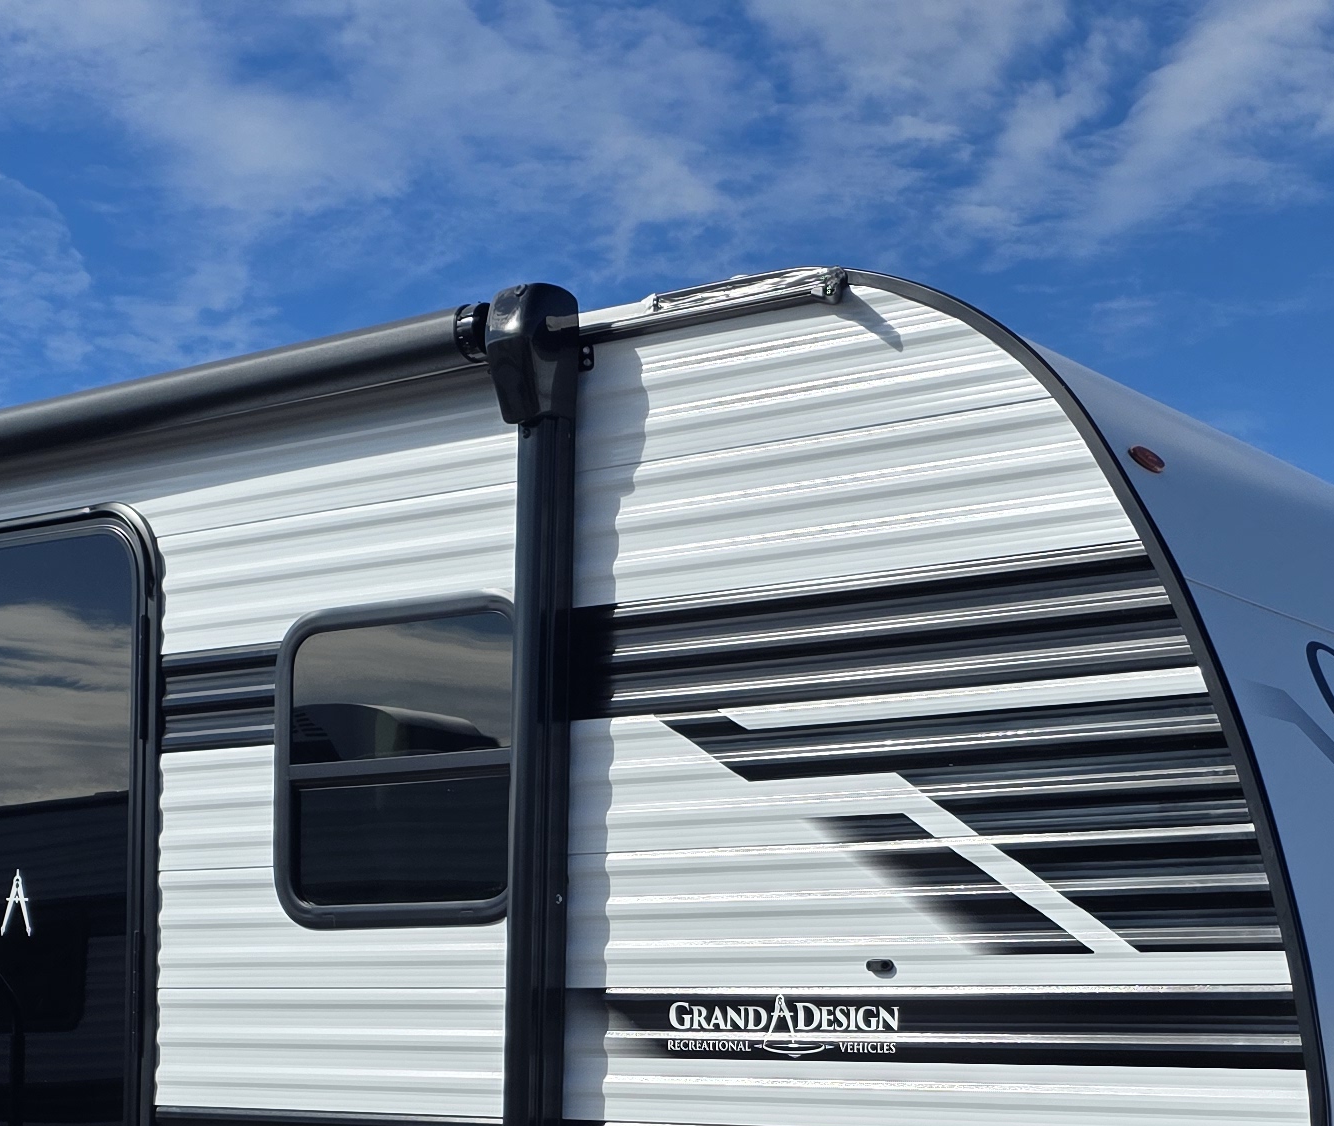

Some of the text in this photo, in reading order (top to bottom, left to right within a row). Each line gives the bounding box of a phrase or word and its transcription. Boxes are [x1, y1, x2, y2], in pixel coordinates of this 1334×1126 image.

[669, 1001, 899, 1031] GRAND DESIGN
[667, 1039, 896, 1054] RECREATIONAL VEHICLES
